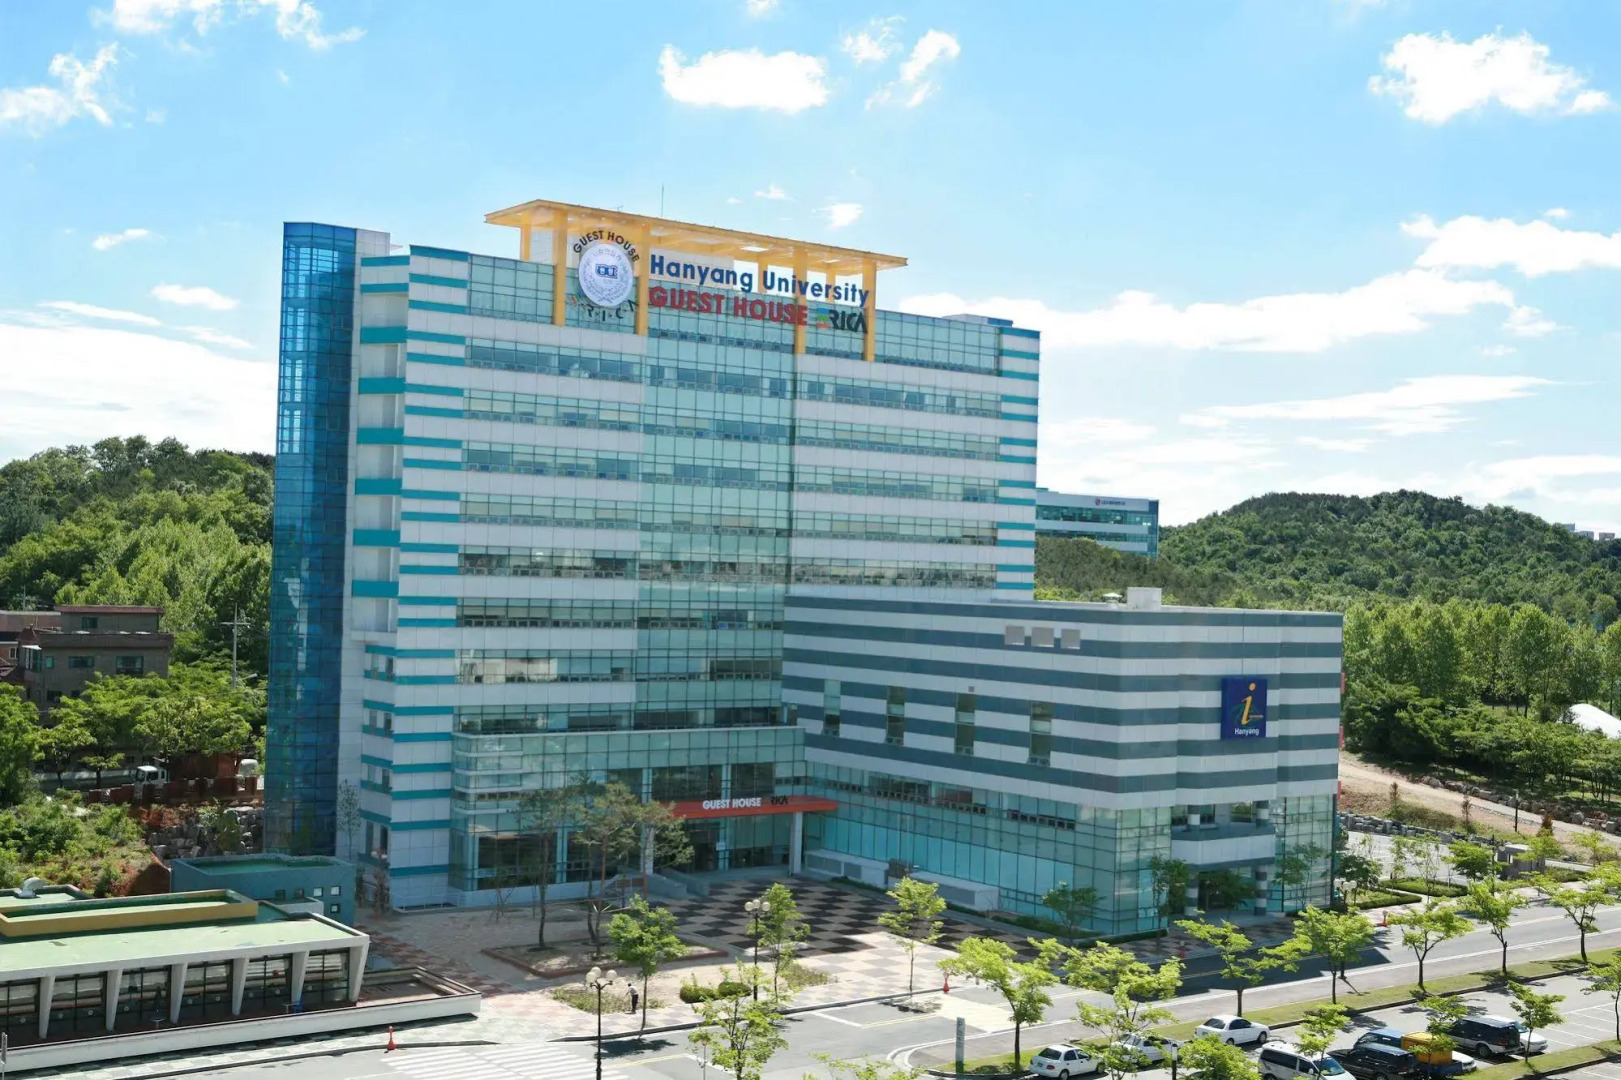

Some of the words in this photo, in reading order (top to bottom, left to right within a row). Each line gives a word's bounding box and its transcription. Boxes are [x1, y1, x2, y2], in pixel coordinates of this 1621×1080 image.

[573, 230, 604, 253] GUEST
[607, 232, 640, 262] HOUSE
[650, 254, 753, 293] Hanyang
[763, 270, 869, 308] University
[649, 286, 726, 315] GUEST
[733, 296, 808, 326] HOUSE
[1234, 728, 1260, 736] Hanyang
[702, 799, 731, 810] GUEST
[732, 797, 762, 809] HOUSE
